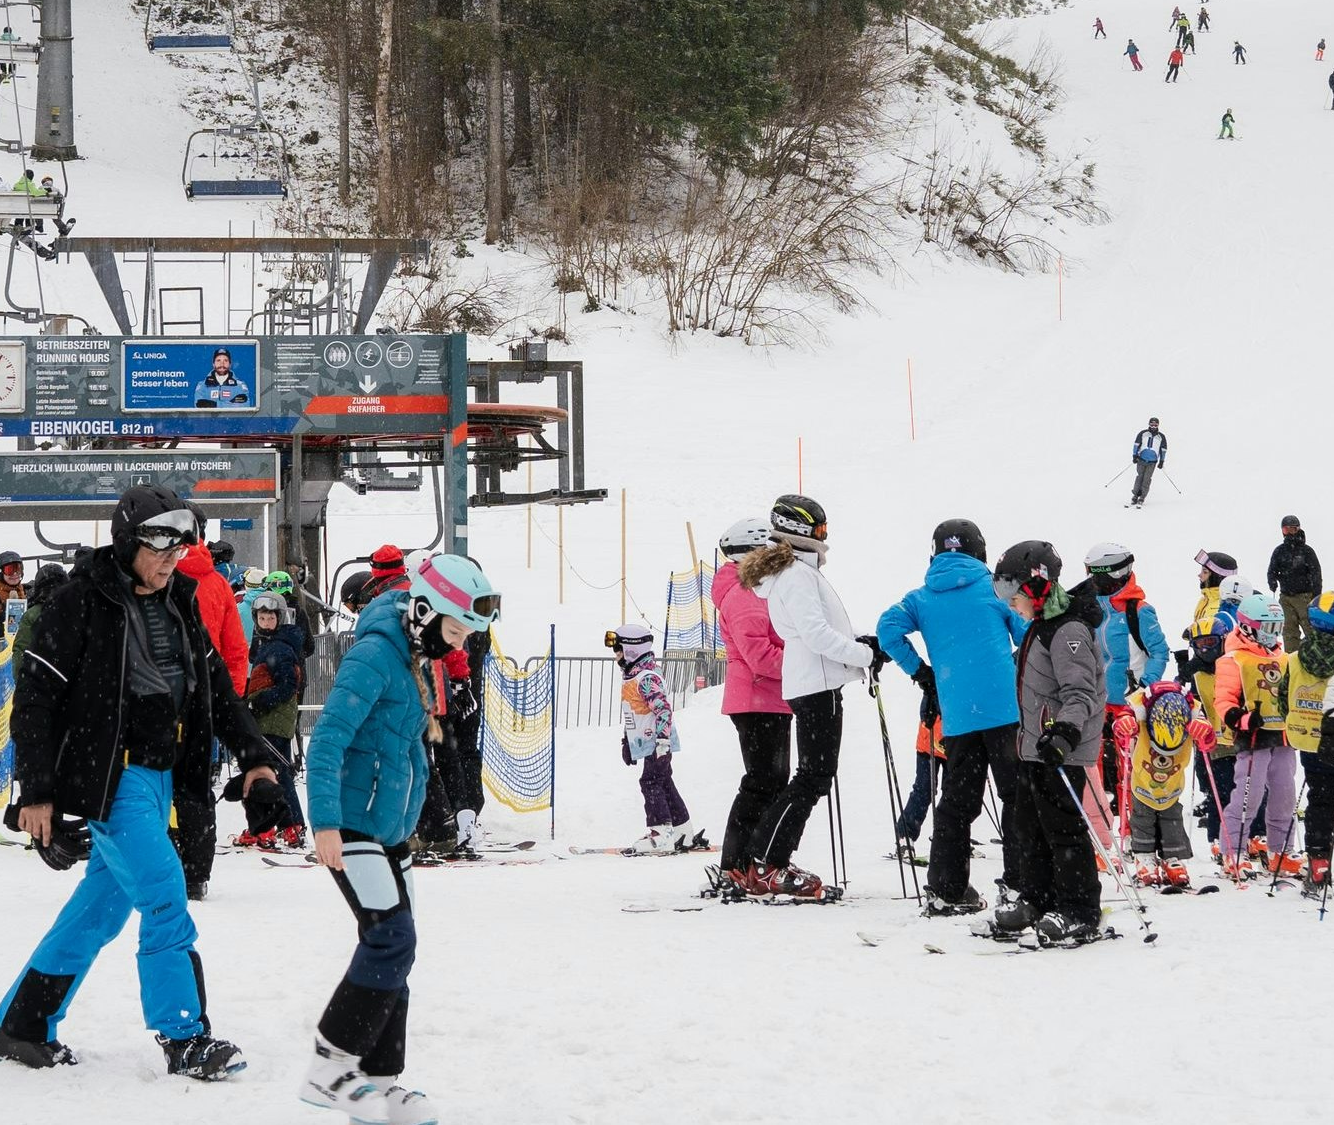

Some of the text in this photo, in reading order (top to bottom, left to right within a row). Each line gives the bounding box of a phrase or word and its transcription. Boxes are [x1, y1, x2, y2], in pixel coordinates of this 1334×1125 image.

[36, 340, 110, 350] BETRIEBSZEITEN
[36, 354, 110, 363] RUNNING HOURS
[144, 352, 167, 360] UNIQA
[131, 370, 185, 379] gemeinsam
[131, 379, 189, 388] besser leben
[352, 397, 380, 405] ZUGANG
[347, 405, 385, 413] SKIFAHRER
[31, 421, 154, 435] EIBENKOGEL 812 m
[12, 461, 231, 473] HERZLICH WILLKOMMEN IN LACKENHOF AM ÖTSCHER!
